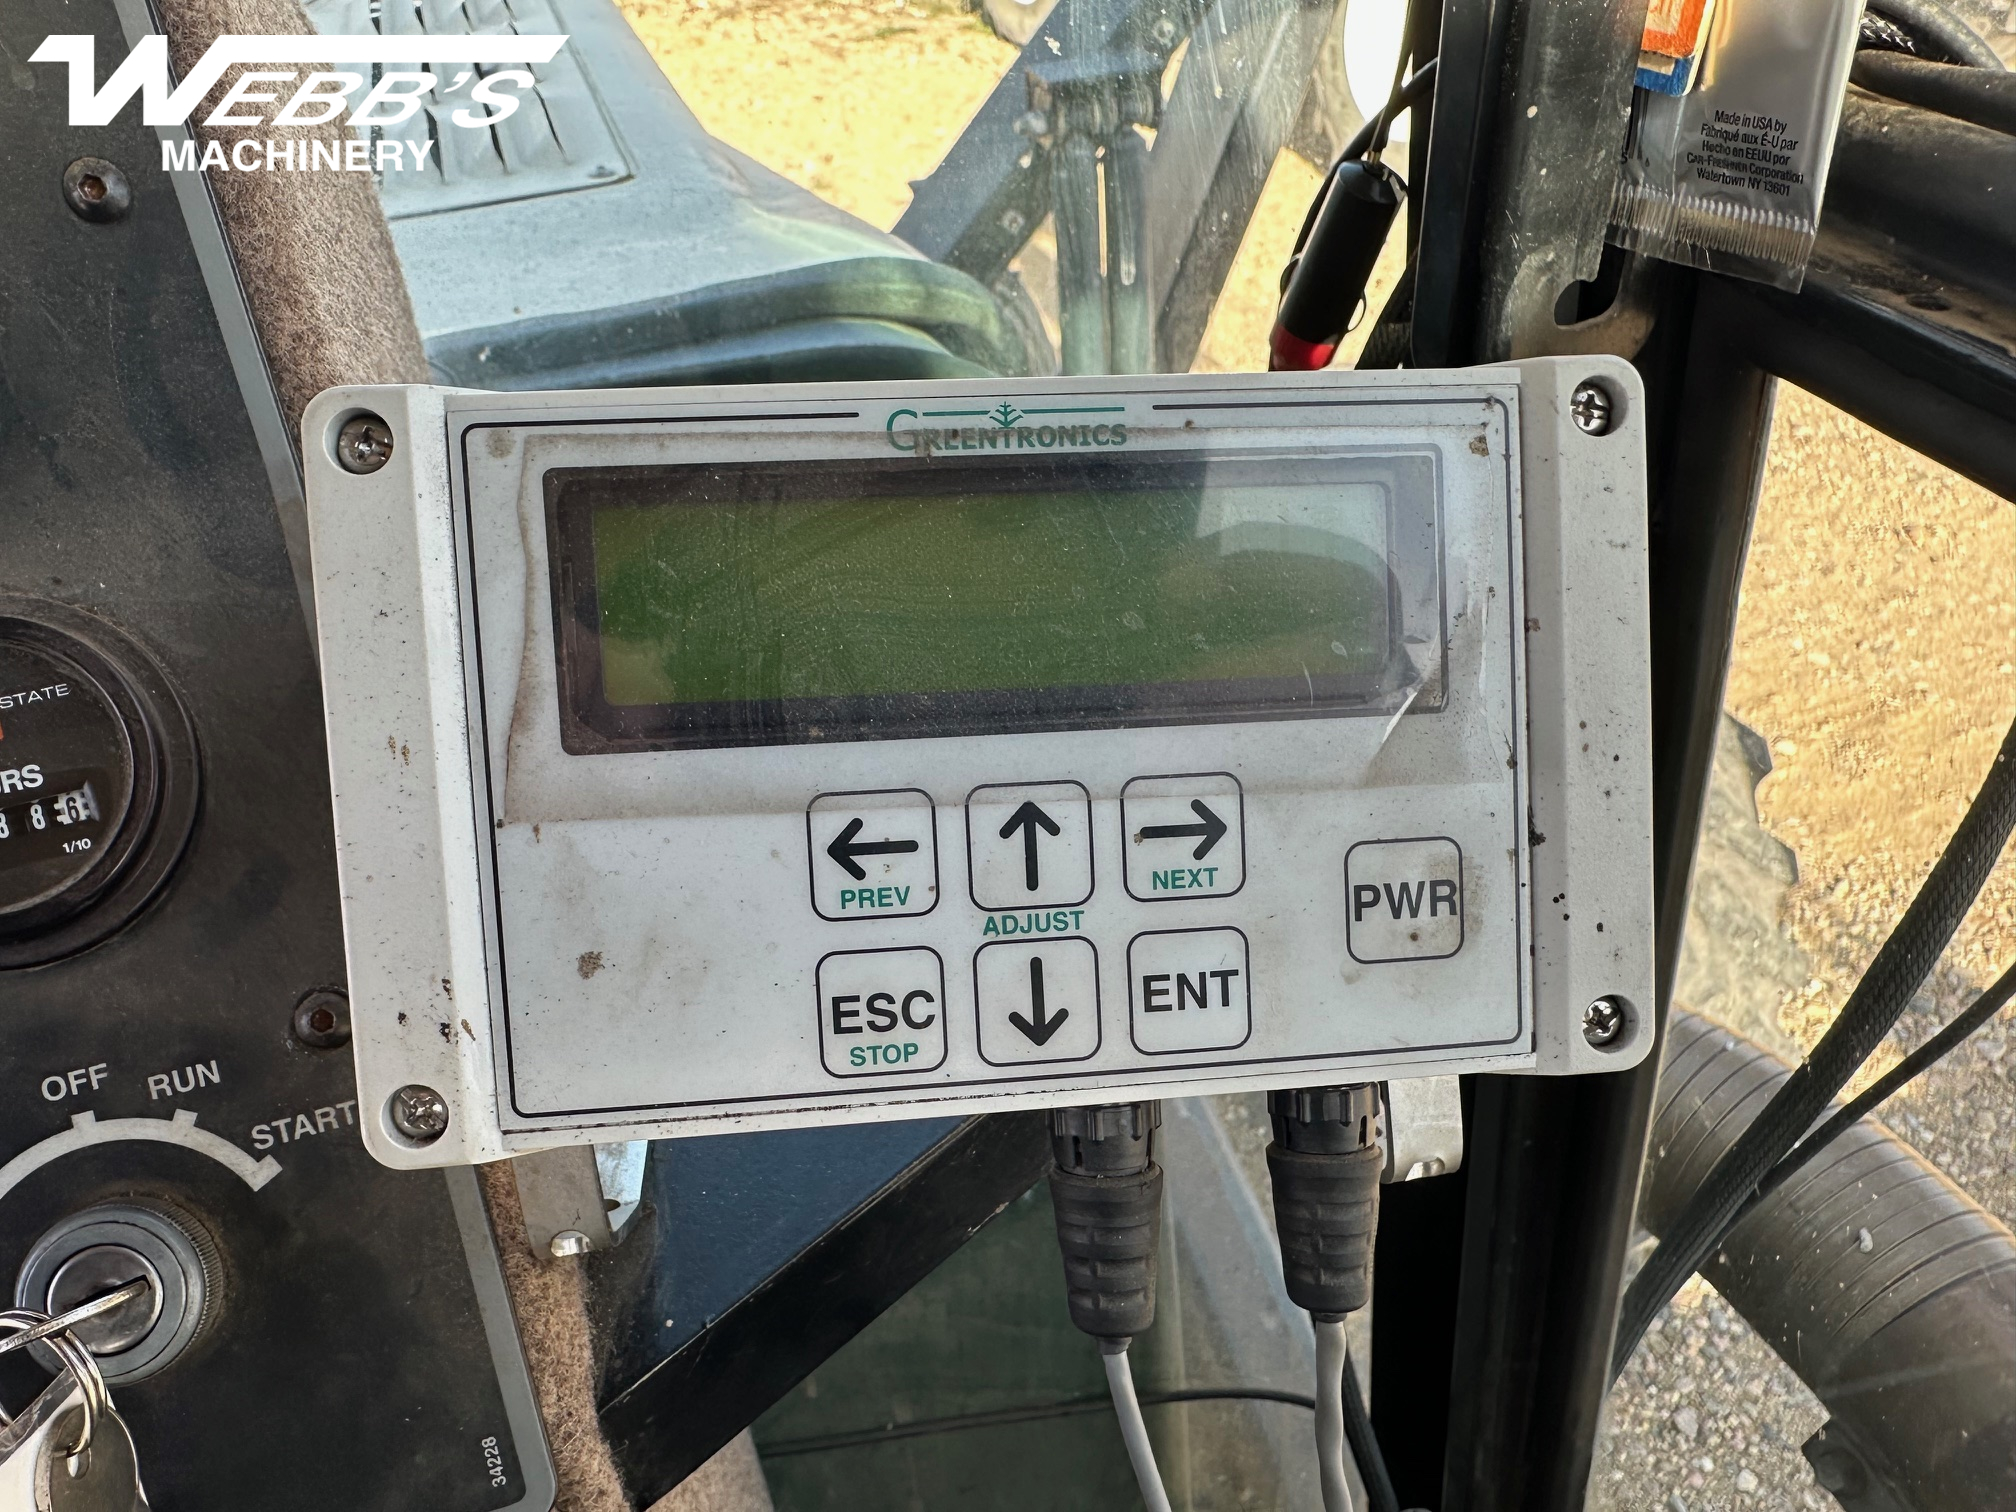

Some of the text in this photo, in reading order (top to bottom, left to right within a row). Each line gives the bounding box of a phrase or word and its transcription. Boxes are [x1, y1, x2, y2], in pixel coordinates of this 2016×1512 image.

[1714, 110, 1787, 135] Made in USA by
[1701, 123, 1740, 144] Fabriqué
[1741, 133, 1759, 145] aux
[1780, 139, 1799, 152] par
[1702, 140, 1791, 166] Hecho en EEUU por
[1697, 167, 1791, 197] Watertown NY 13601
[1749, 163, 1804, 184] Corporation
[886, 409, 1127, 452] GREENTRONICS
[0, 683, 69, 709] STATE
[0, 764, 44, 794] RS
[62, 838, 92, 854] 1/10
[1151, 867, 1219, 891] NEXT
[840, 885, 911, 910] PREV
[1353, 879, 1458, 922] PWR
[982, 910, 1085, 936] ADJUST
[1142, 969, 1239, 1013] ENT
[831, 989, 936, 1035] ESC
[849, 1043, 919, 1067] STOP
[41, 1063, 108, 1101] OFF
[147, 1060, 221, 1100] RUN
[251, 1099, 356, 1150] START
[481, 1436, 507, 1488] 34228
